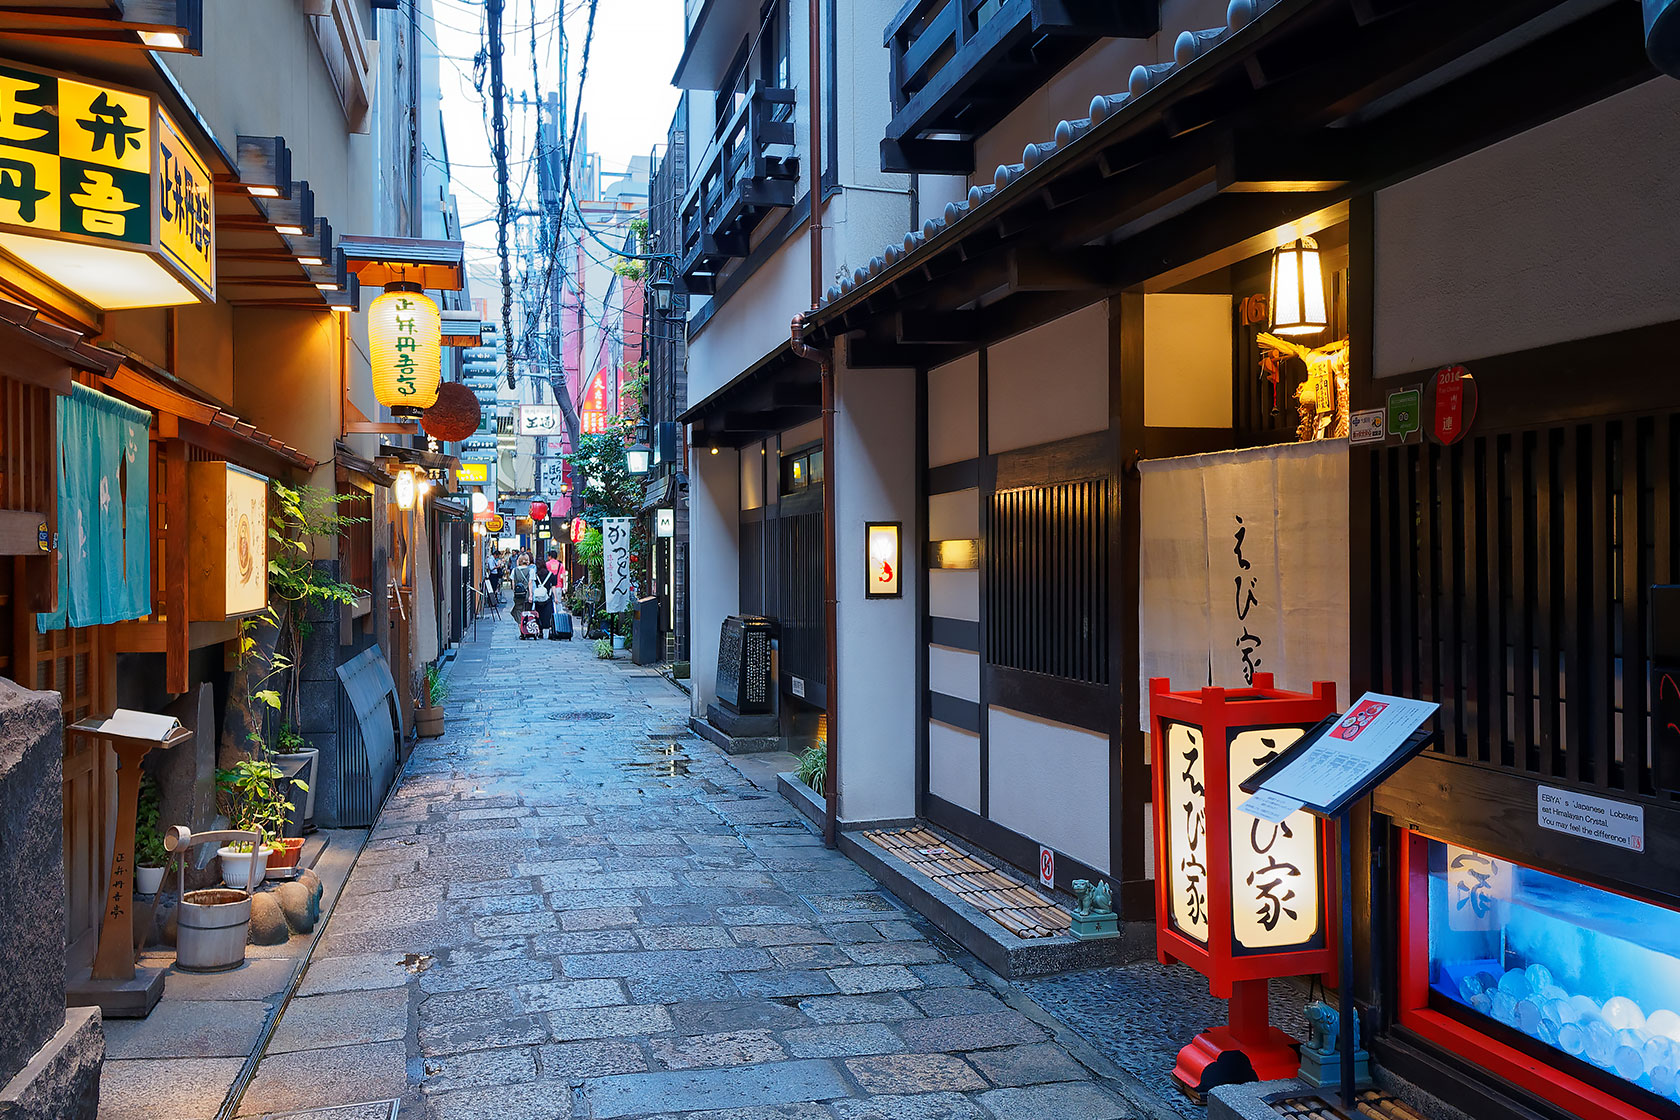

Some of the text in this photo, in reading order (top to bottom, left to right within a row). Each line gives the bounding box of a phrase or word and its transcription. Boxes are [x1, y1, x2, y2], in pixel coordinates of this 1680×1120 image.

[1239, 294, 1266, 326] 16
[1541, 806, 1552, 814] eat
[1553, 808, 1584, 821] Himalayan
[1609, 808, 1639, 822] Lobsters
[1542, 816, 1555, 826] You
[1556, 821, 1569, 830] may
[1569, 822, 1581, 833] feel
[1581, 826, 1593, 836] the
[1593, 829, 1627, 844] difference
